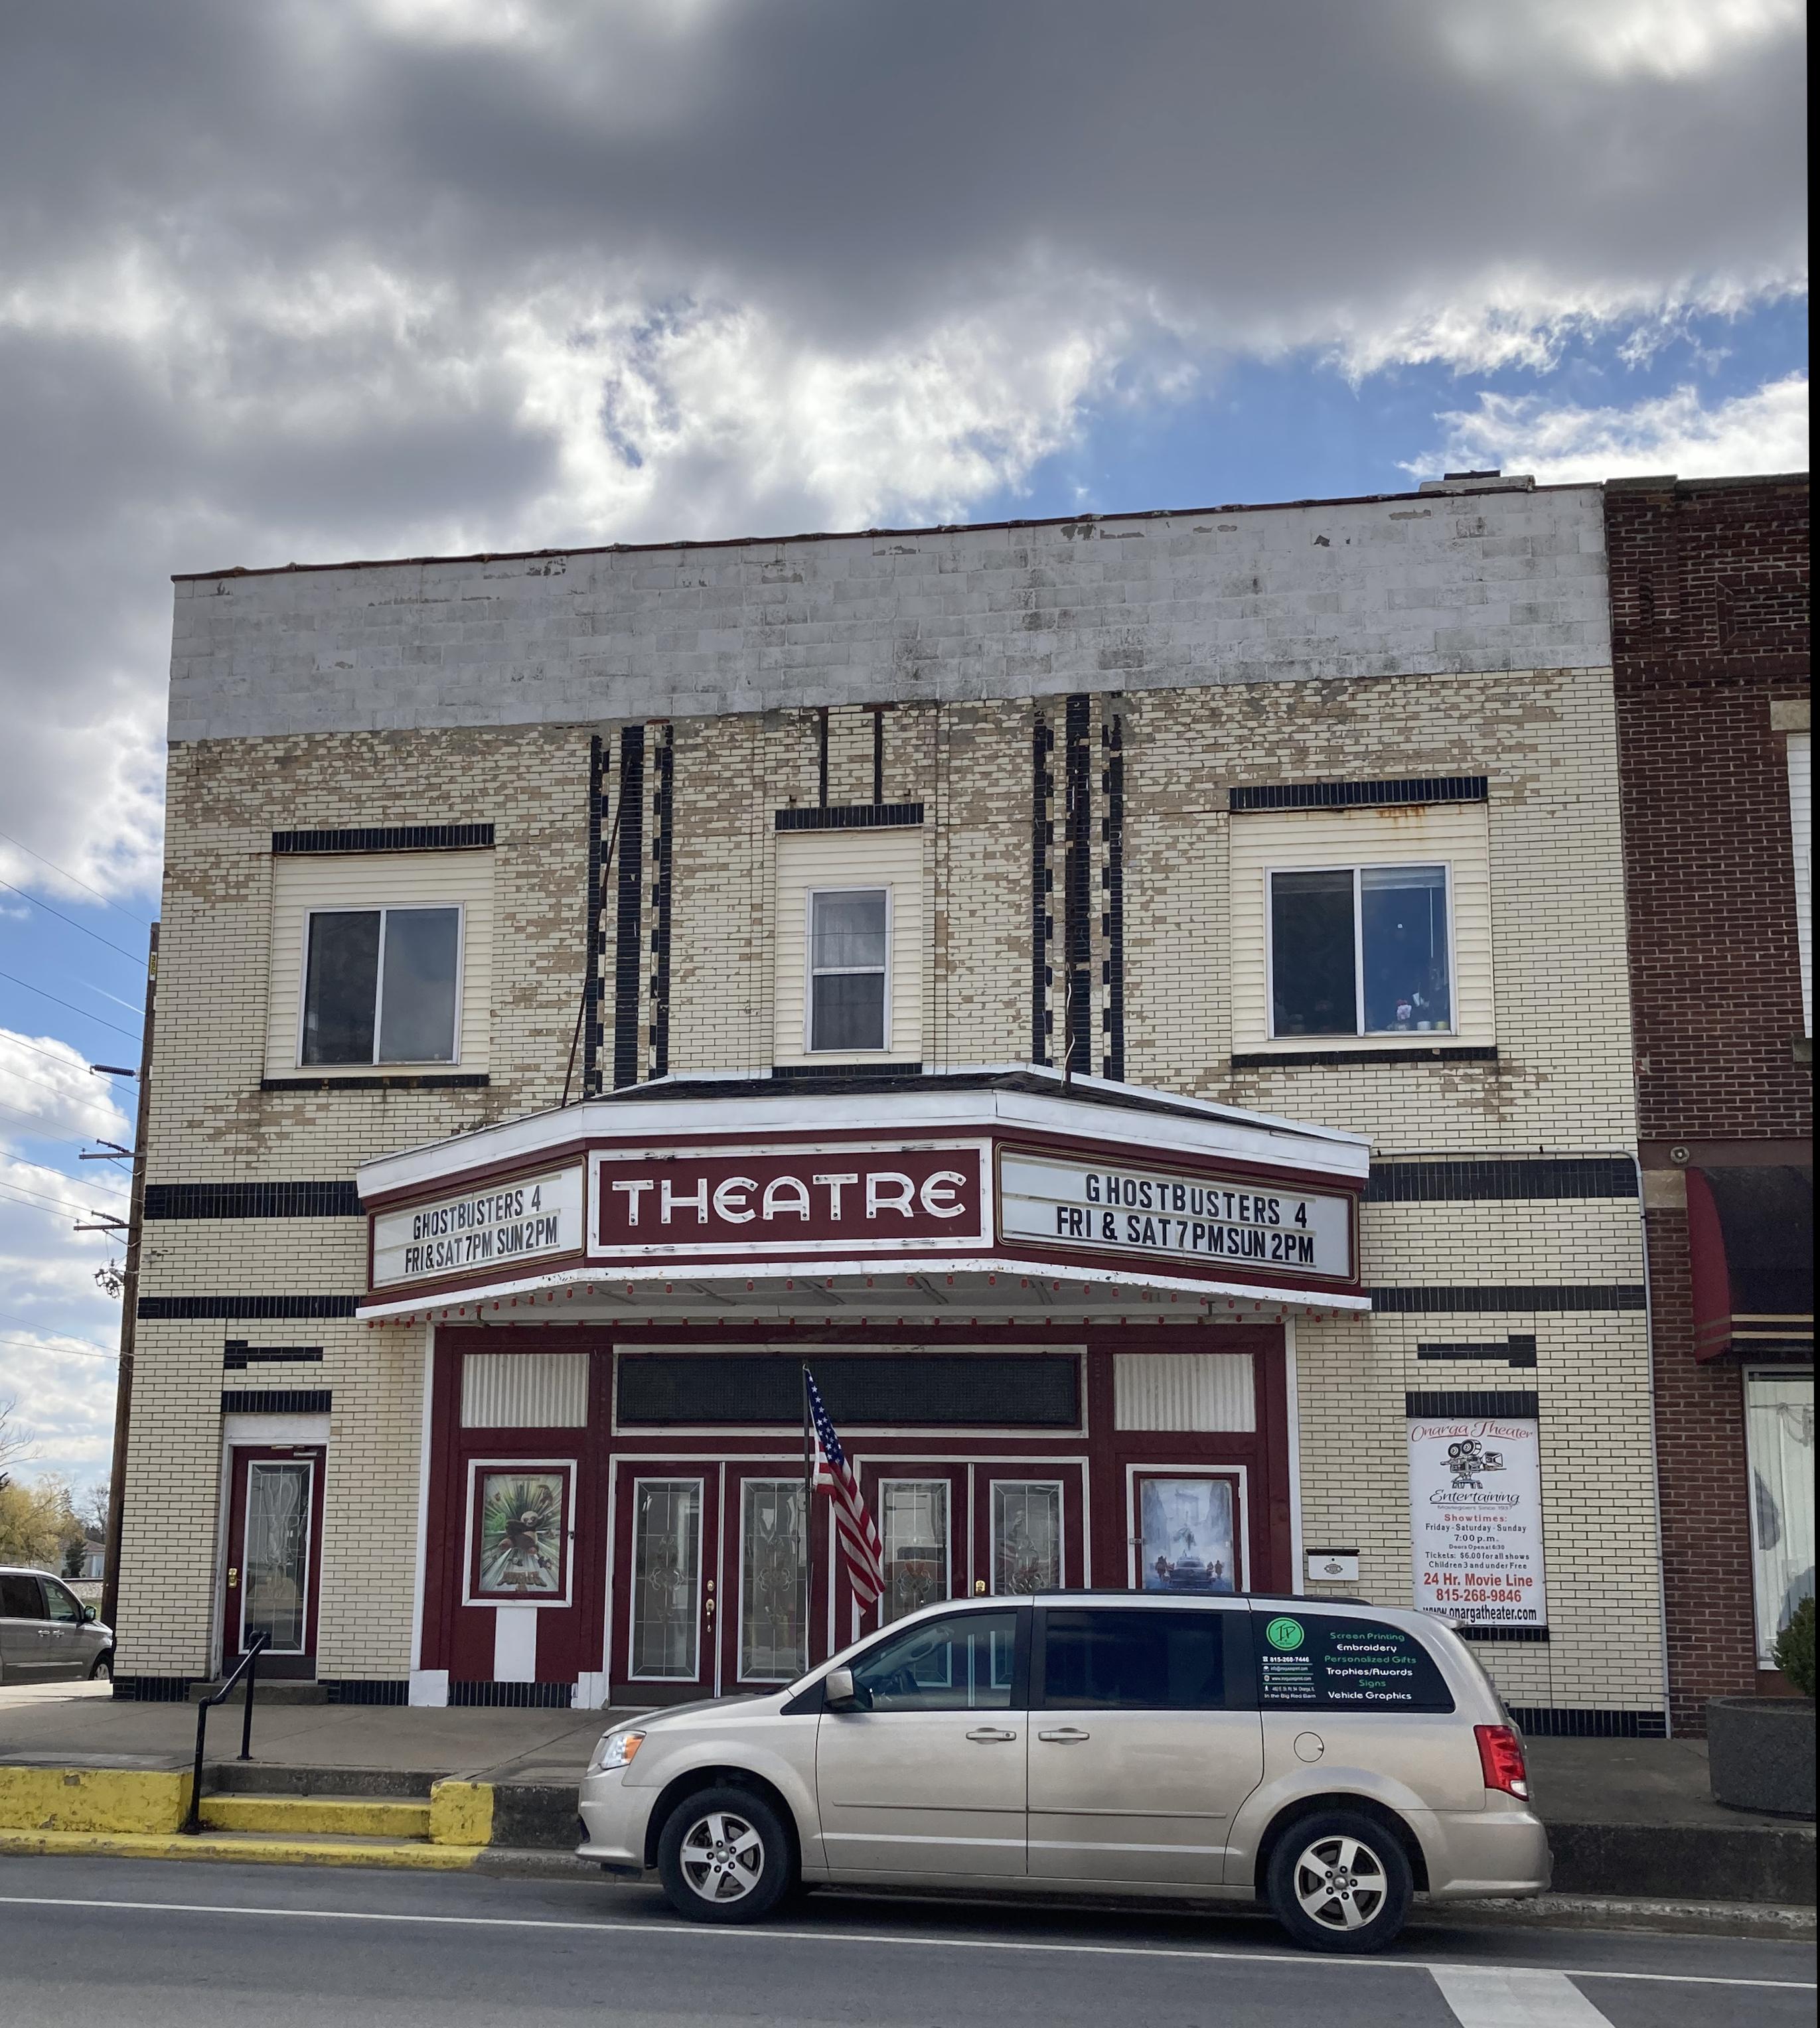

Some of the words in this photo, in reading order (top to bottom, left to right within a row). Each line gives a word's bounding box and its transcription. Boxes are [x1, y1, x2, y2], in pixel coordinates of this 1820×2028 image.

[612, 1170, 967, 1226] THEATRE
[1087, 1173, 1280, 1226] GHOSTBUSTERS
[1294, 1202, 1308, 1228] 4
[413, 1189, 524, 1240] GHOSTBUSTERS
[531, 1185, 542, 1212] 4
[1057, 1206, 1092, 1238] FRI
[1102, 1211, 1118, 1241] &
[1411, 1424, 1469, 1442] Onarga
[1470, 1419, 1533, 1439] Theater
[1429, 1488, 1521, 1506] Entertaining
[1444, 1514, 1507, 1522] Showtimes:
[1425, 1523, 1450, 1533] Friday
[1456, 1524, 1491, 1533] Saturday
[1497, 1524, 1527, 1534] Sunday
[1424, 1572, 1439, 1585] 24
[1443, 1573, 1460, 1585] Hr.
[1465, 1573, 1501, 1586] Movie
[1506, 1573, 1533, 1587] Line
[1436, 1588, 1522, 1603] 815-268-9846
[1367, 1633, 1405, 1642] Printing
[1337, 1644, 1397, 1652] Embroidery
[1326, 1667, 1413, 1676] Trophies/Awards
[1359, 1680, 1387, 1688] Signs
[1365, 1692, 1412, 1701] Graphics
